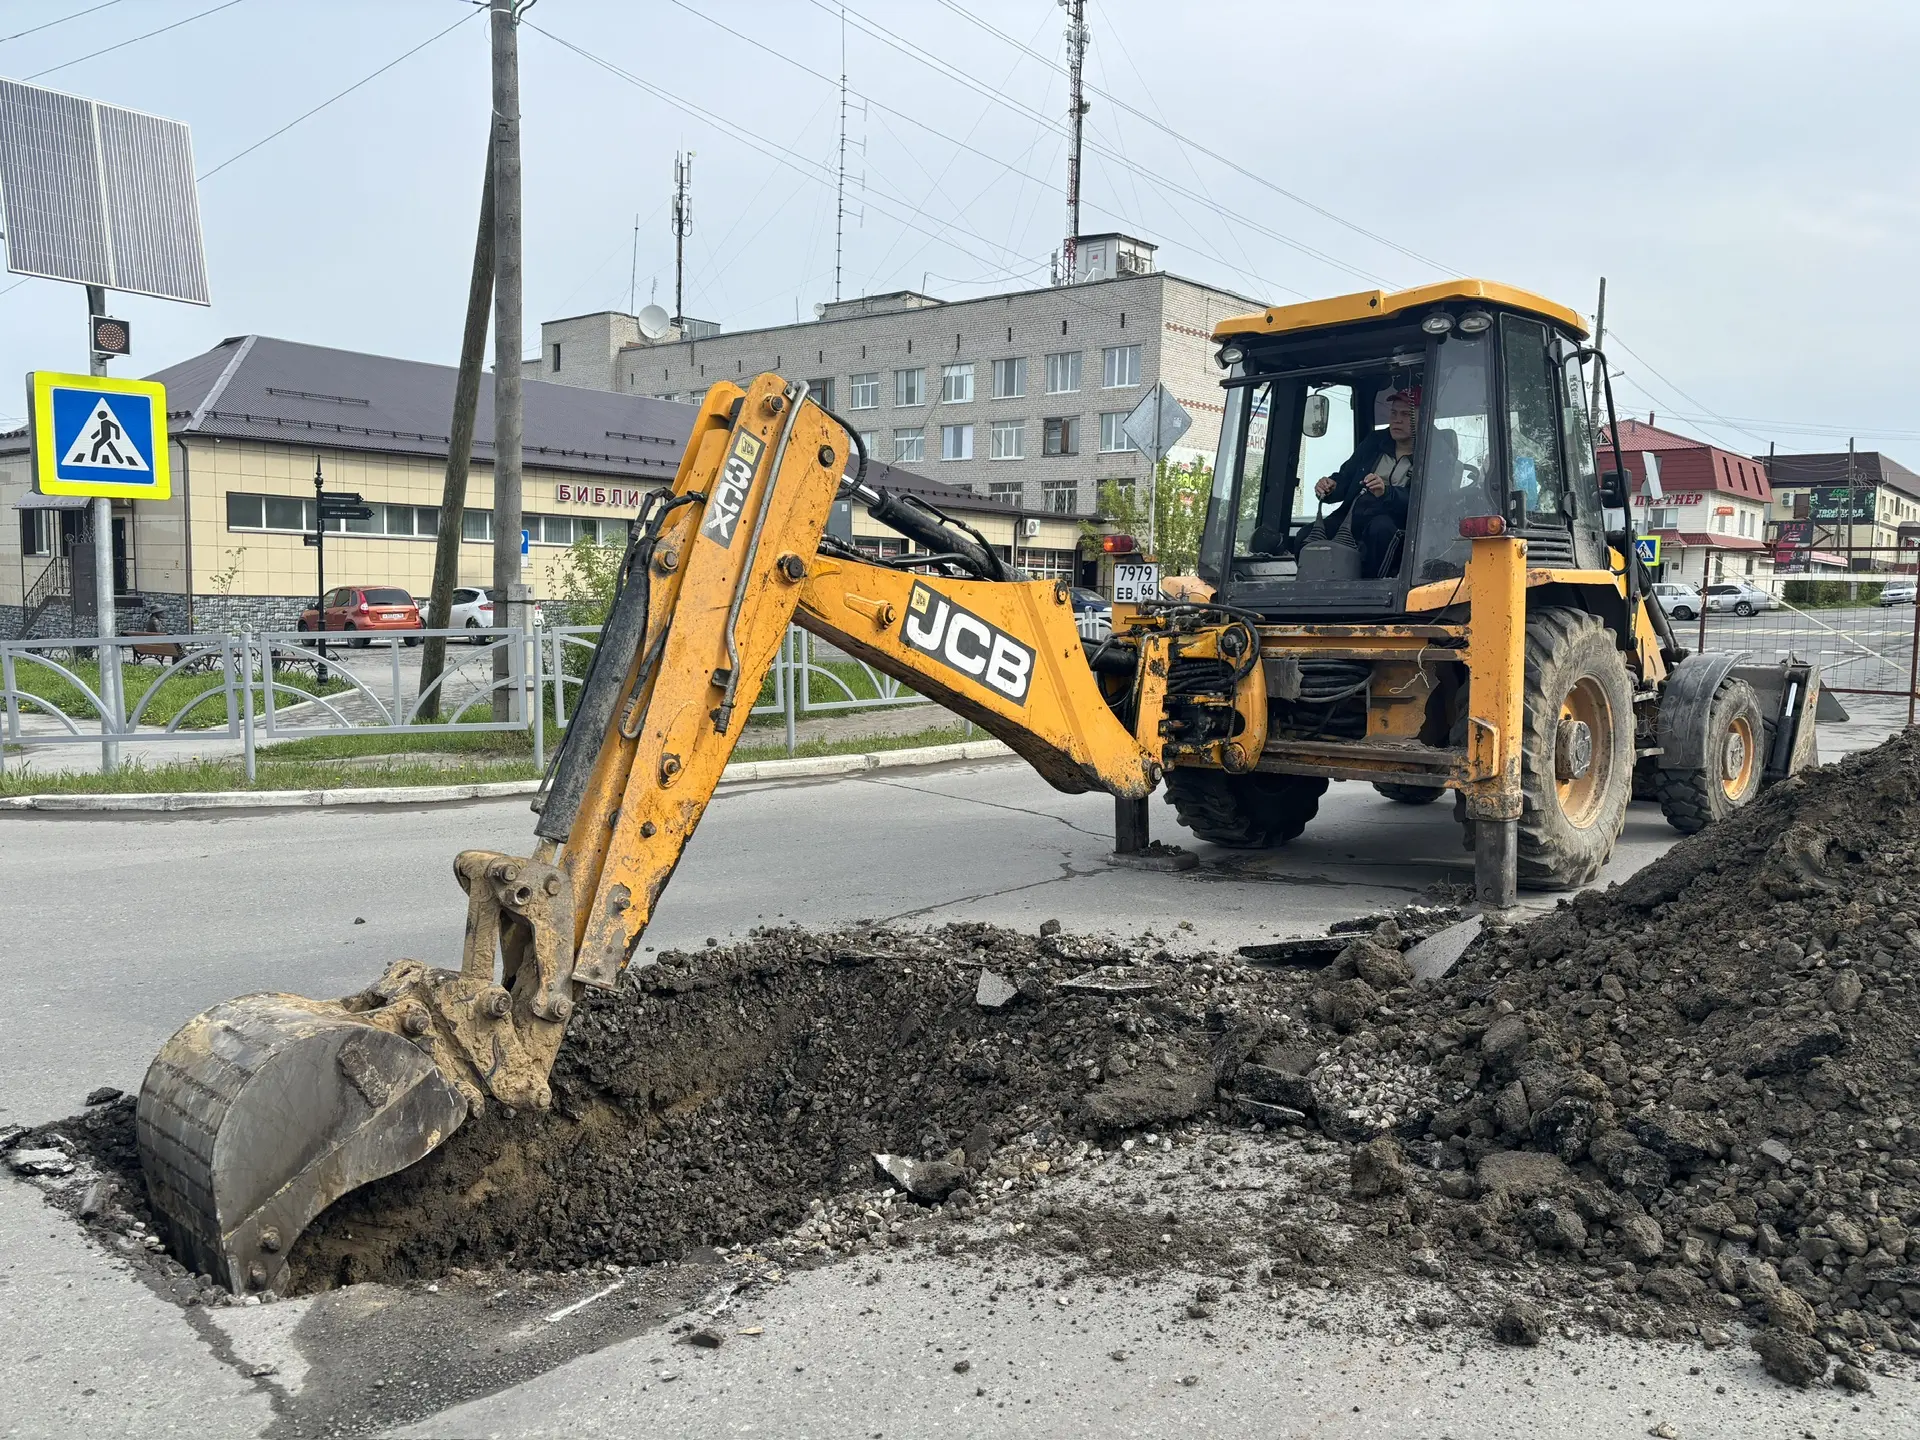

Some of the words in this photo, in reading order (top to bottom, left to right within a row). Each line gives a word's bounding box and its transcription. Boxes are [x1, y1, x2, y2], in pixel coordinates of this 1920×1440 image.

[558, 484, 645, 507] БИБЛИ
[706, 457, 752, 540] 3CX
[1120, 566, 1152, 581] 7979
[1141, 584, 1153, 595] 66
[906, 600, 1031, 698] JCB
